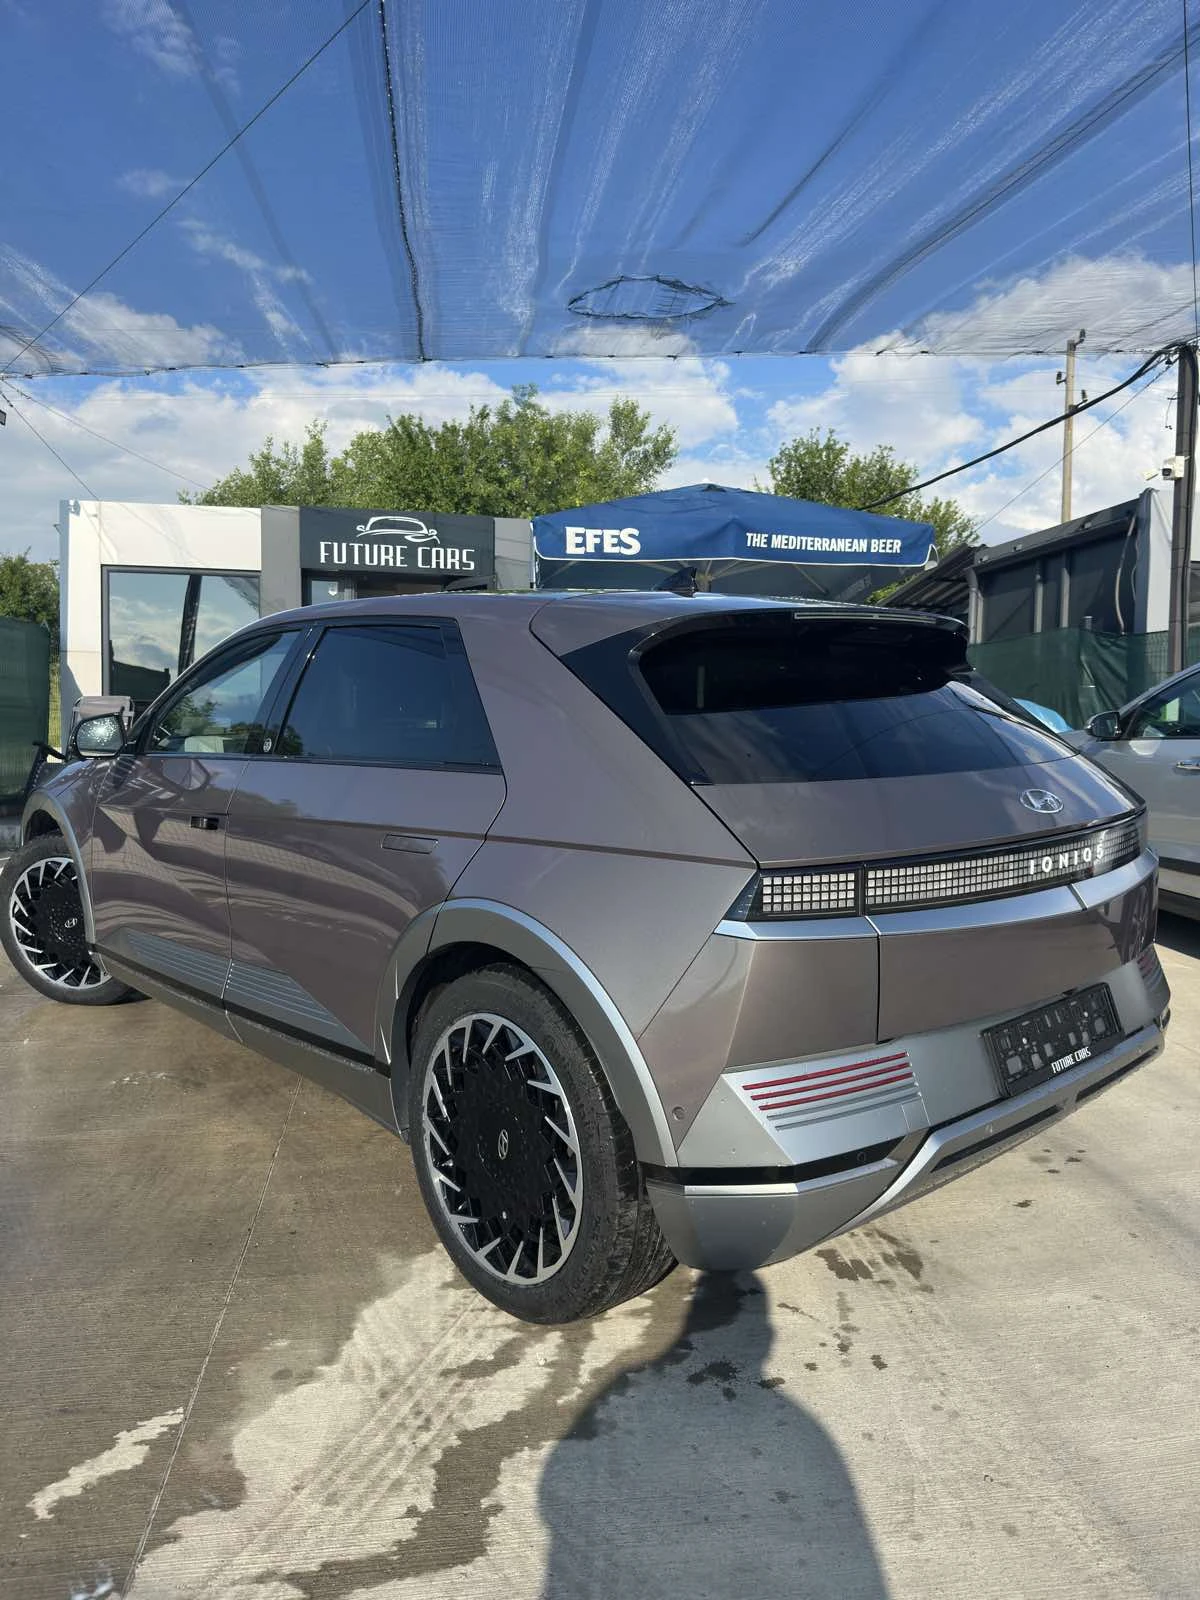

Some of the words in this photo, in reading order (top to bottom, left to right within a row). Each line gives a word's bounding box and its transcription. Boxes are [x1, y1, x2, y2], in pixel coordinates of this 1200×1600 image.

[565, 526, 641, 555] EFES
[746, 532, 768, 548] THE
[771, 534, 867, 553] MEDITERRANEAN
[870, 538, 901, 554] BEER
[319, 541, 408, 567] FUTURE
[417, 546, 475, 571] CARS
[1051, 1053, 1076, 1074] FUTURE
[1074, 1046, 1092, 1062] CARS
